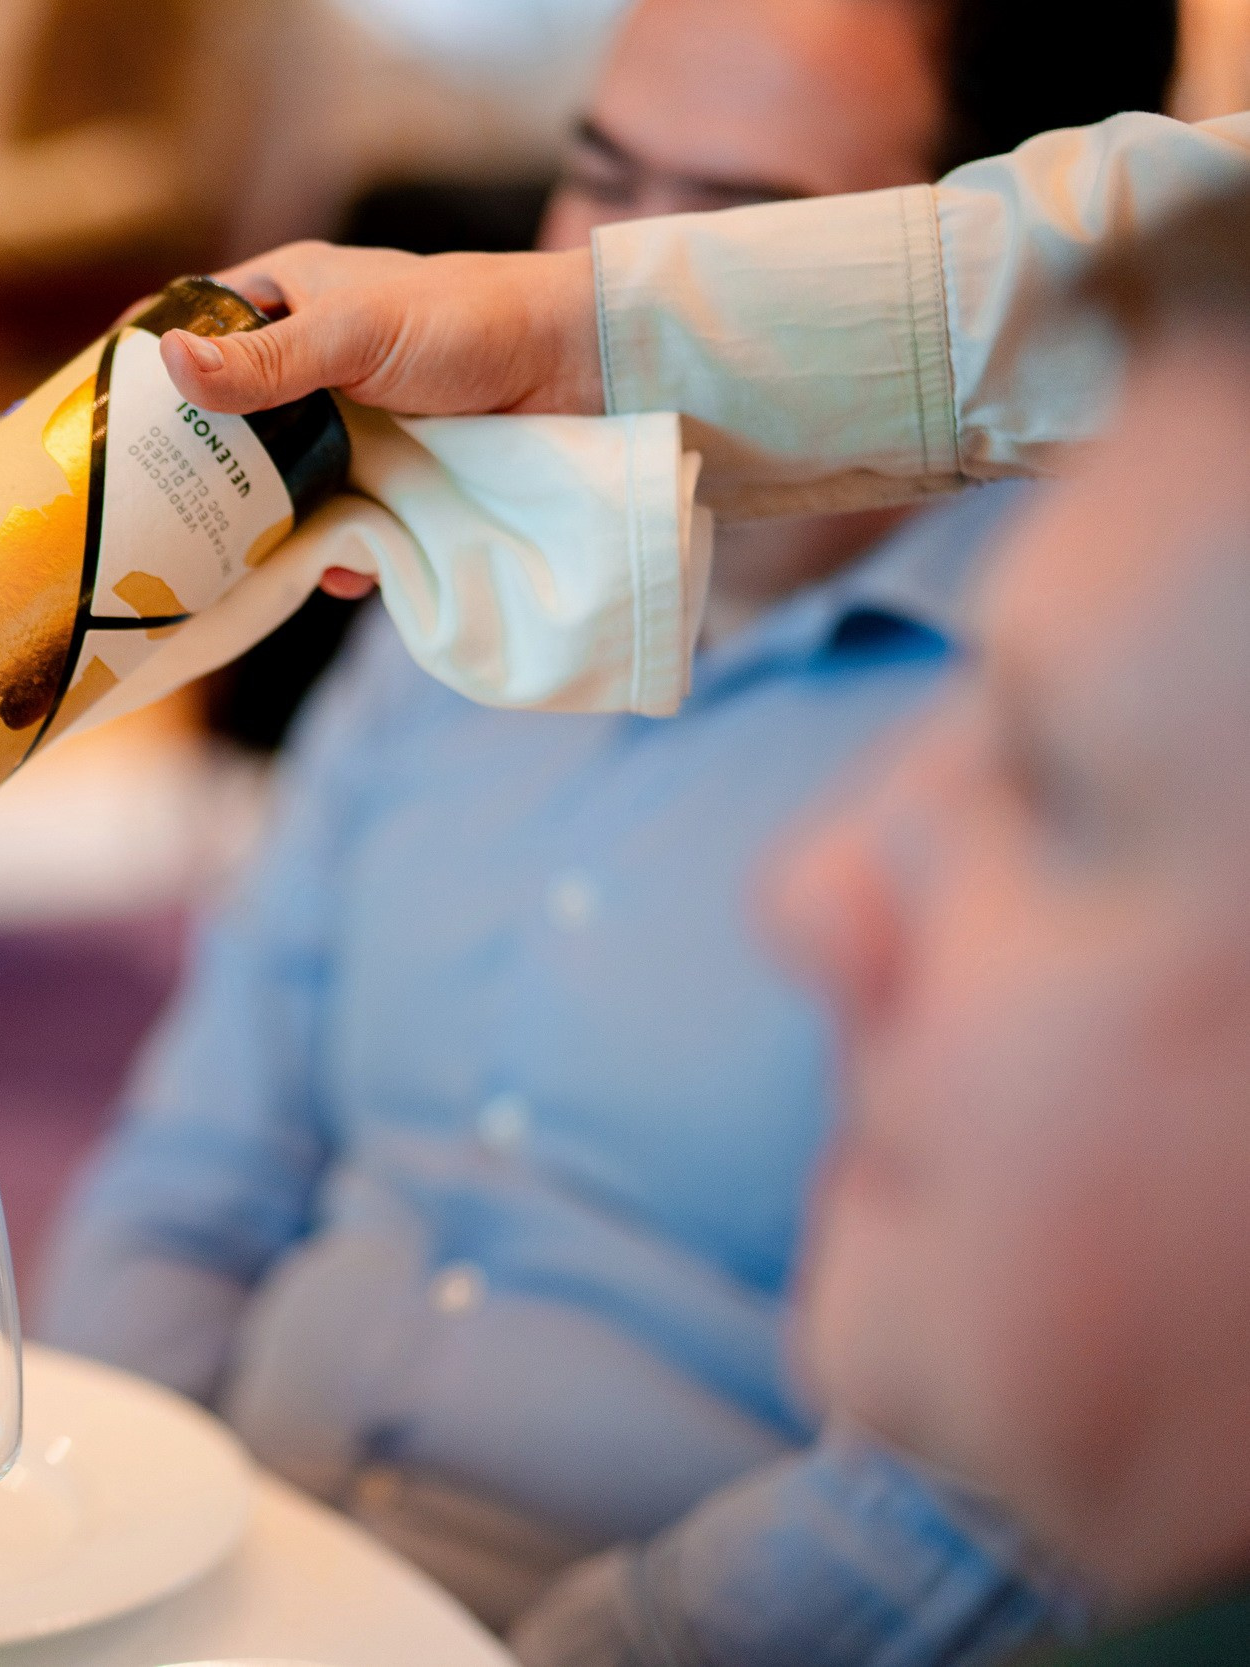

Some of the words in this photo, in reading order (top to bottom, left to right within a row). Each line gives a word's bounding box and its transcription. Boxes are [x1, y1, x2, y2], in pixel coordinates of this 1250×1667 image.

[137, 434, 170, 462] JESI
[149, 425, 209, 497] CLASSICO
[168, 467, 185, 486] DI
[175, 401, 250, 498] VELENOSI
[127, 443, 197, 533] VERDICCHIO
[206, 500, 229, 531] DOC
[181, 489, 226, 555] CASTELLI
